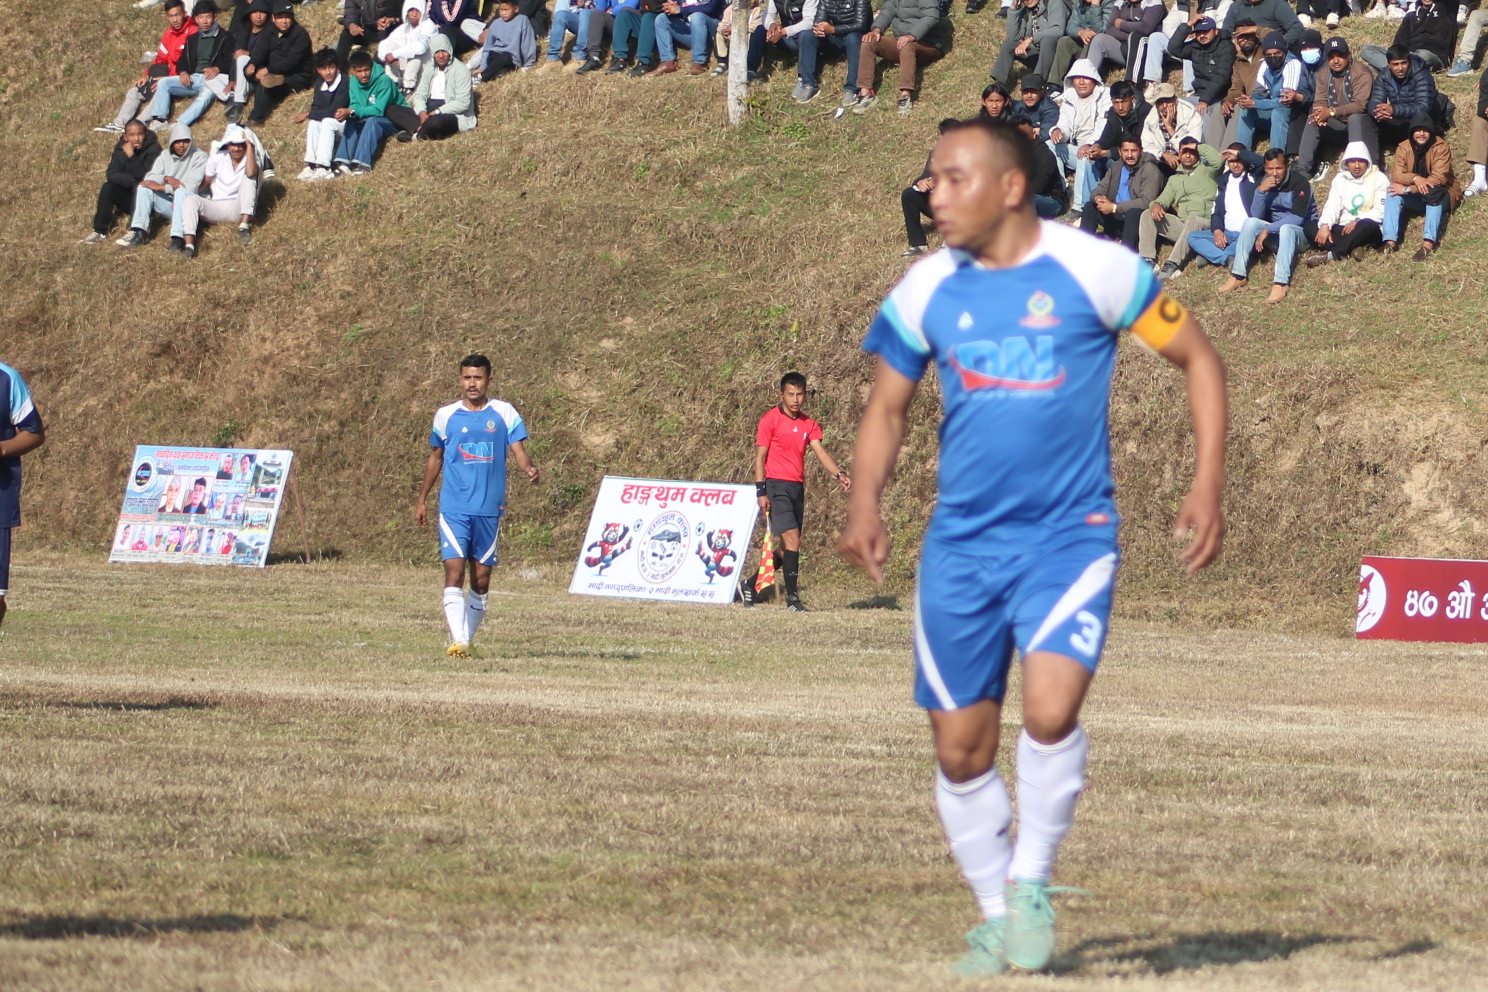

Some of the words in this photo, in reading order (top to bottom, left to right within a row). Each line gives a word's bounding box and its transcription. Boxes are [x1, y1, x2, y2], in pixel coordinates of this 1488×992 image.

[1404, 590, 1438, 617] ४७
[1446, 580, 1475, 619] औ
[1070, 610, 1102, 657] 3
